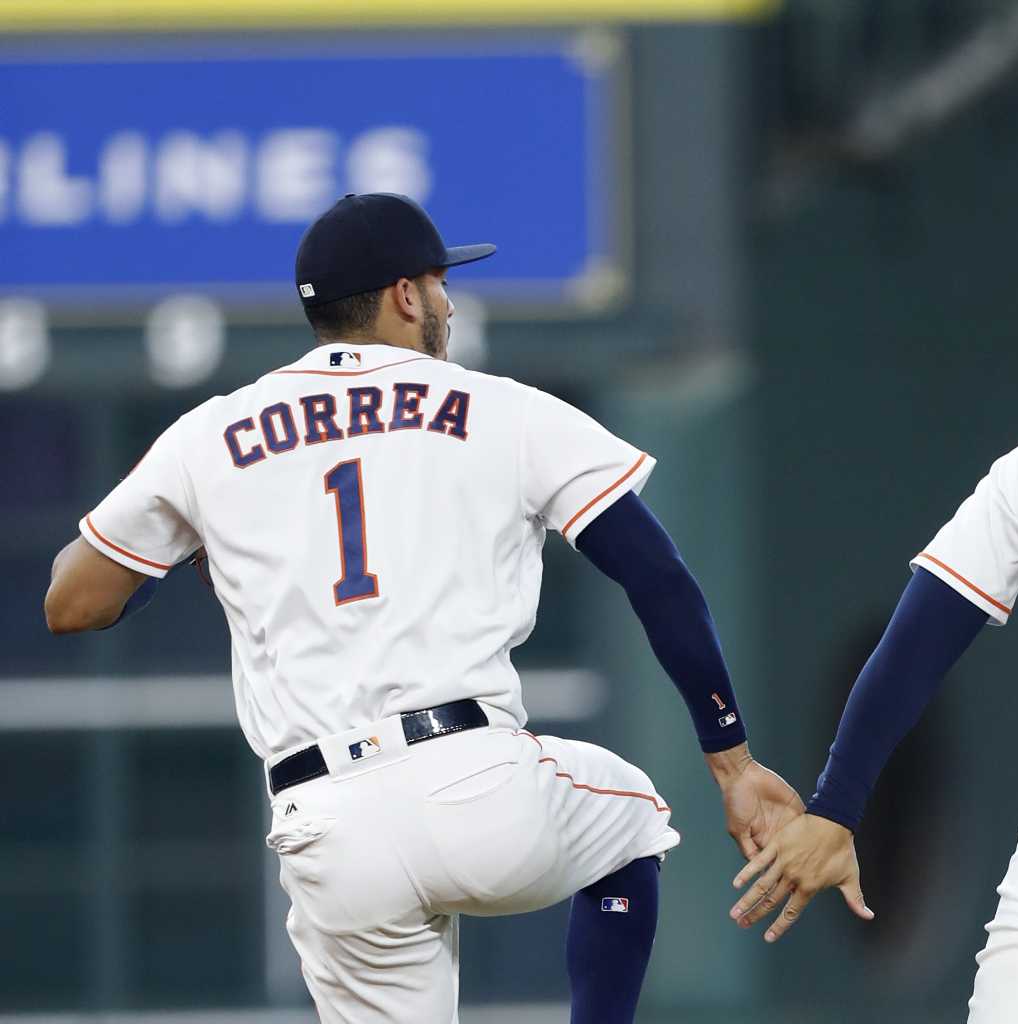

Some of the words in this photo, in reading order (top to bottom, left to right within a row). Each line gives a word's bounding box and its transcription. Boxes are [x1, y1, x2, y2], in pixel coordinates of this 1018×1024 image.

[0, 126, 432, 226] LINES
[223, 382, 470, 469] CORREA
[323, 457, 379, 607] 1
[711, 692, 726, 710] 1
